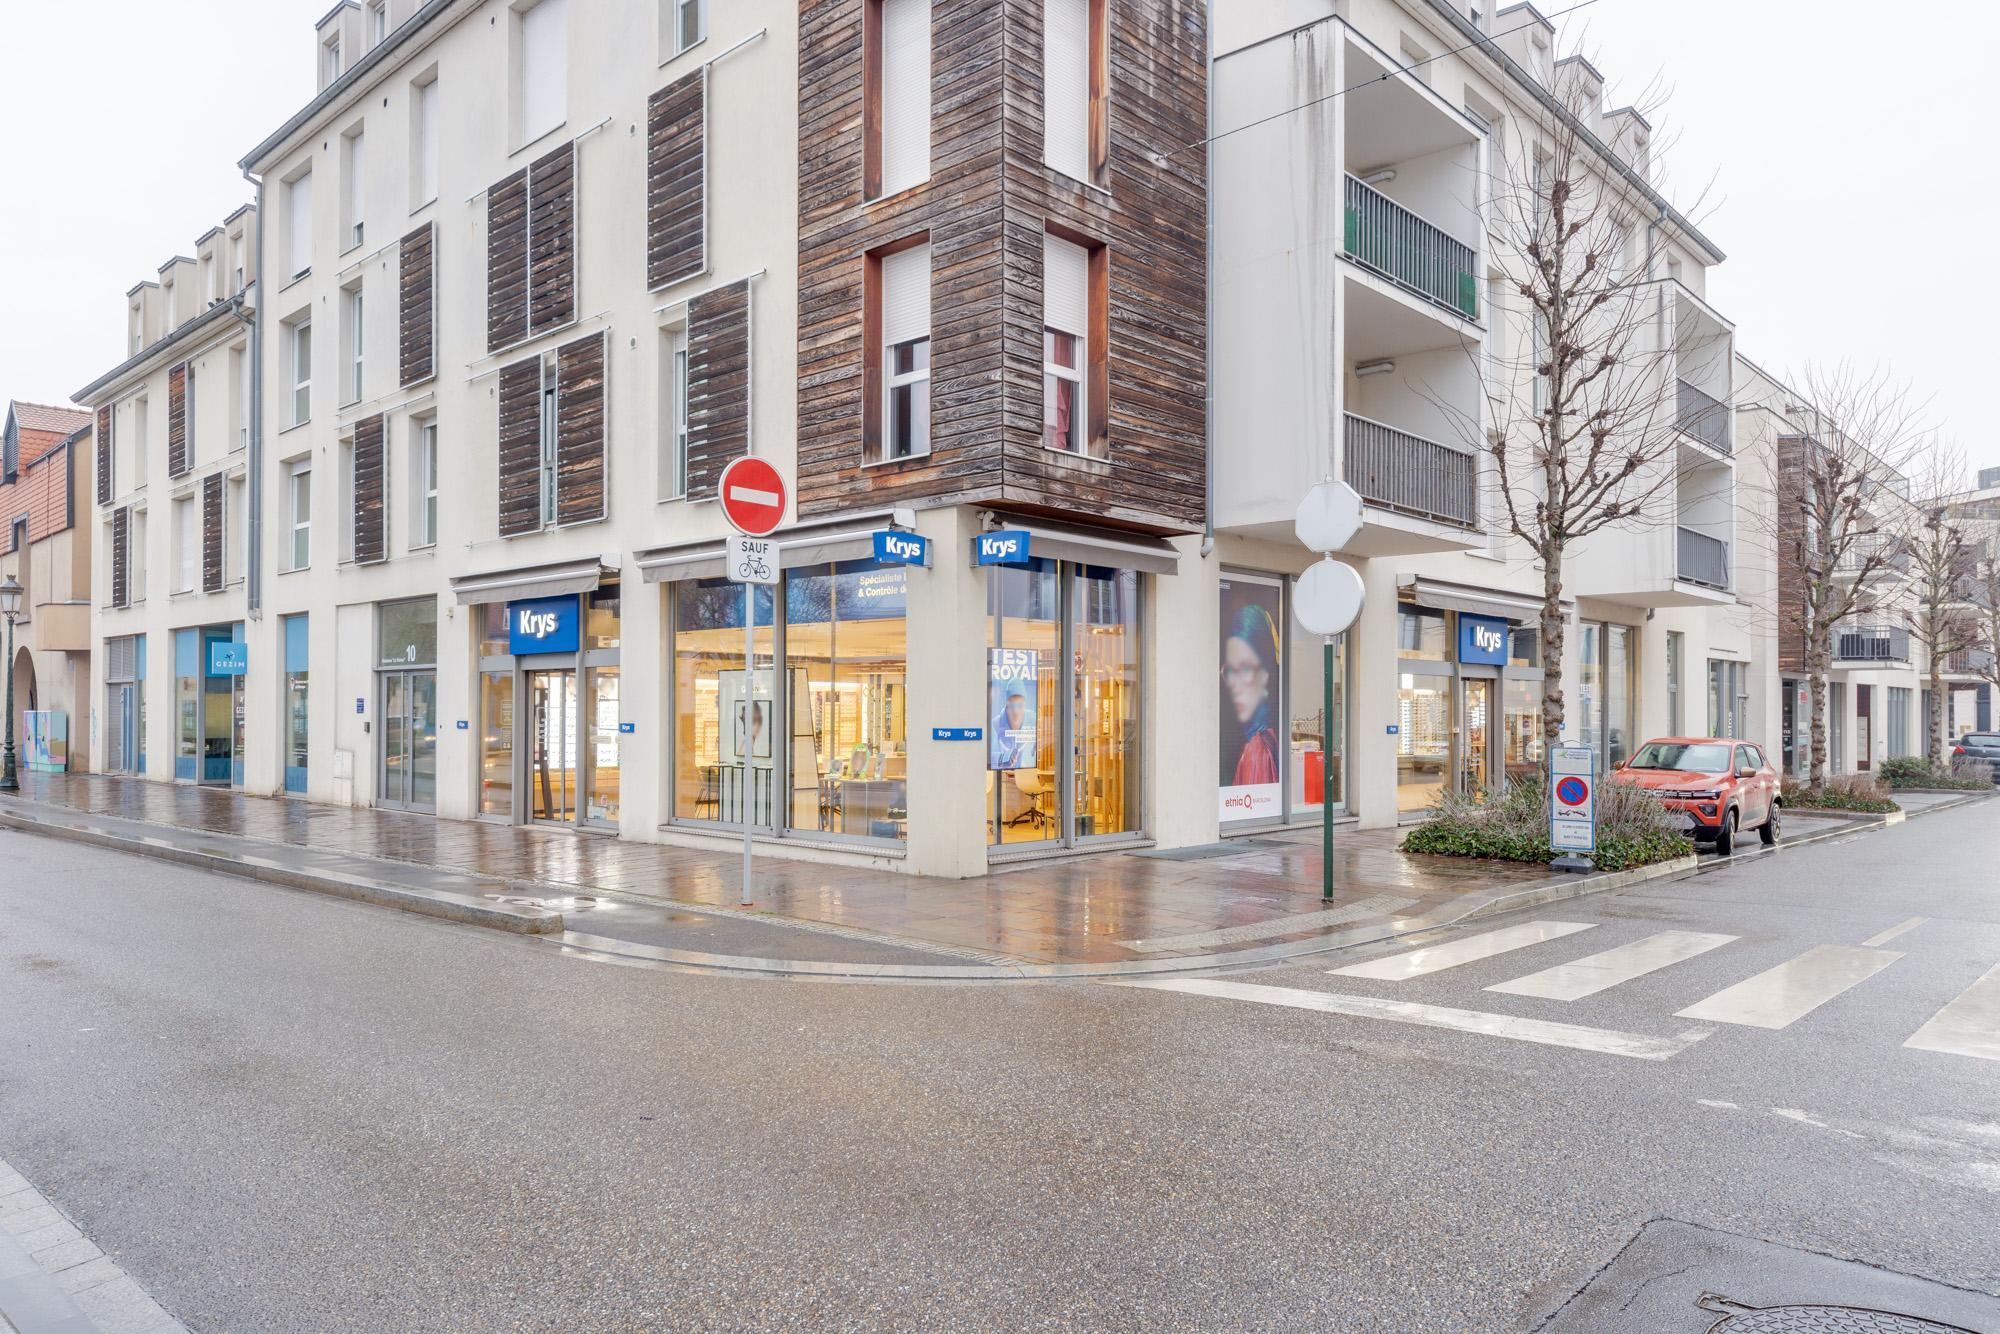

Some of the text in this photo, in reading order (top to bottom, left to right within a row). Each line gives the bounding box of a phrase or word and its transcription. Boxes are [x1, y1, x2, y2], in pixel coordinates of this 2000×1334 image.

[741, 541, 769, 554] SAUF
[885, 536, 921, 558] Krys
[982, 538, 1017, 557] Krys
[860, 574, 902, 585] Spécialiste
[858, 588, 864, 597] &
[866, 586, 898, 597] Contrôle
[520, 609, 557, 639] Krys
[1476, 626, 1501, 652] Krys
[406, 644, 416, 662] 10
[993, 649, 1037, 665] TEST
[992, 665, 1037, 680] ROYAL
[938, 730, 977, 738] Krys Krys
[1225, 796, 1243, 807] etnia
